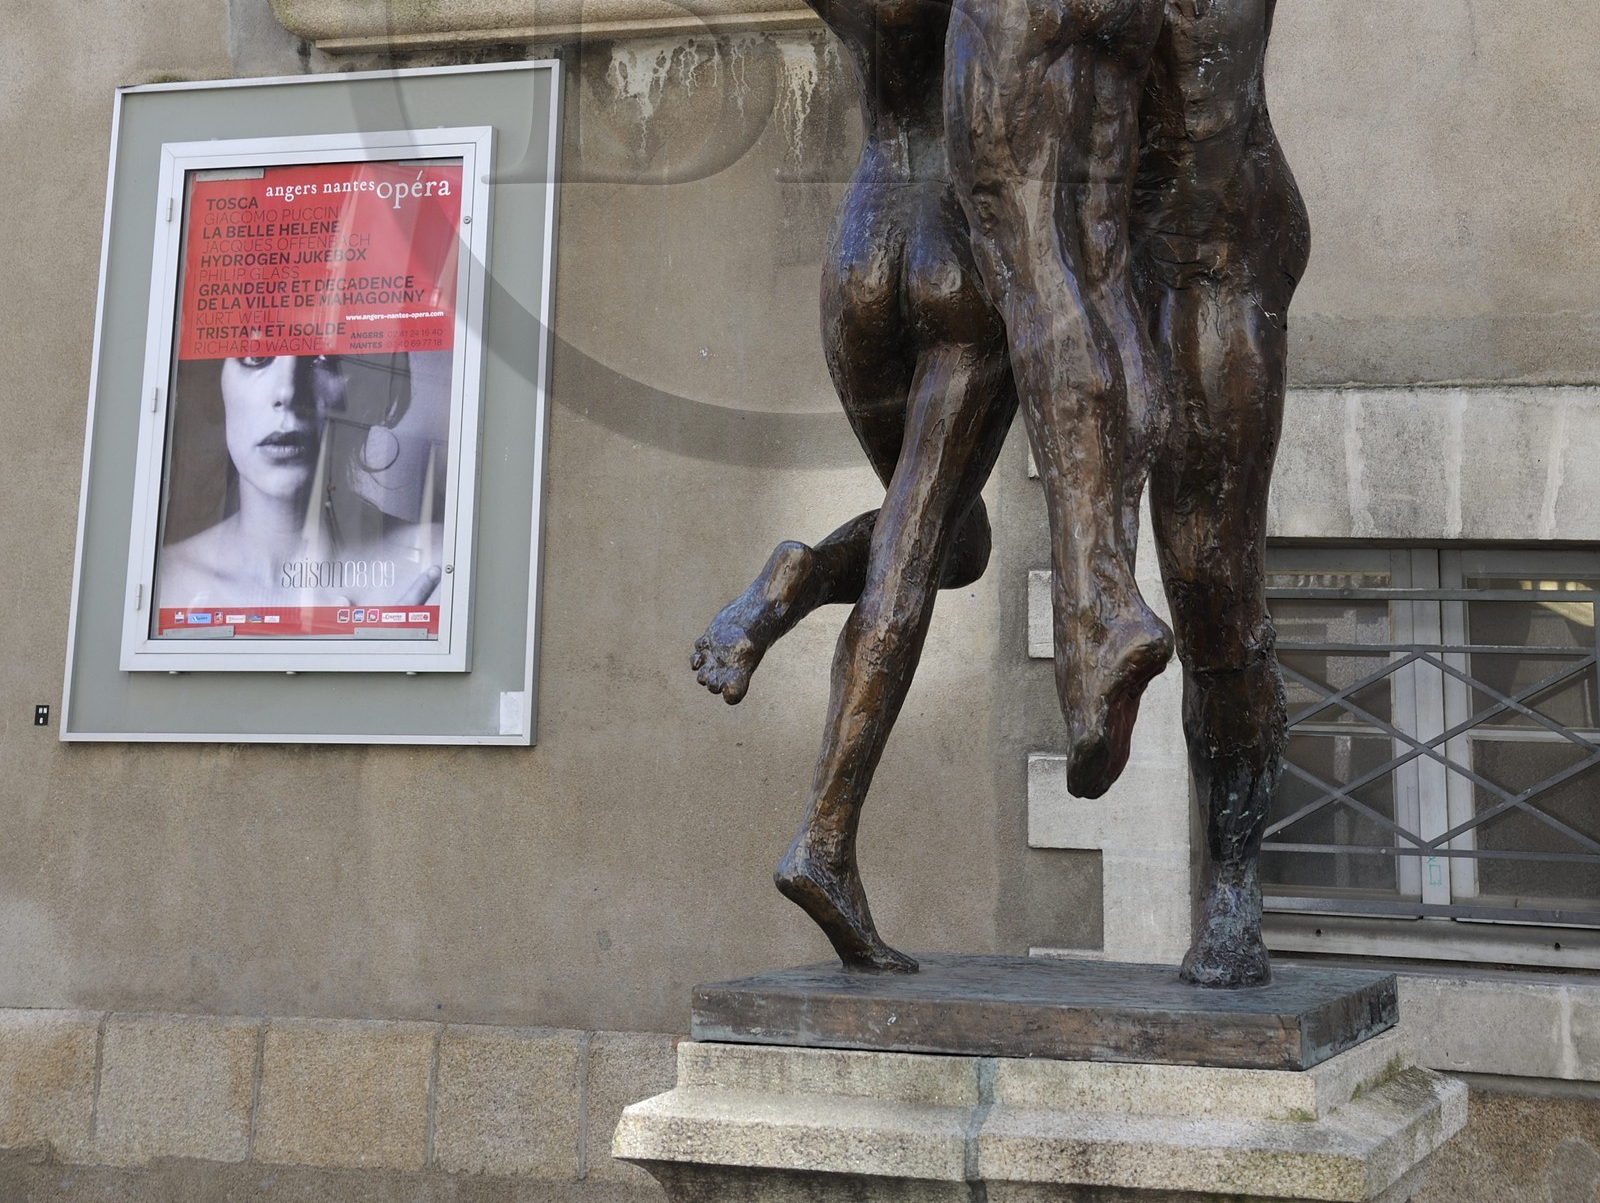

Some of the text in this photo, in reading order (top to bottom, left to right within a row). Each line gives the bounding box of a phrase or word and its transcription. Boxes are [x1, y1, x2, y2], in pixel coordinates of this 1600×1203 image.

[266, 170, 451, 209] angers nantes opéra
[207, 197, 258, 211] TOSCA
[204, 209, 278, 225] GIACOMO
[203, 221, 340, 239] LA BELLE HELENE
[202, 233, 370, 254] JACQUES OFFENBACH
[201, 248, 366, 268] HYDROGEN JUKEBOX
[200, 266, 300, 282] PHILIP GLASS
[199, 275, 414, 296] GRANDEUR ET DECADENCE
[197, 289, 424, 311] DE LA VILLE DE MAHAGONNY
[196, 309, 285, 326] KURT WEILL
[345, 311, 444, 321] www.angers-nantes-opera.com
[196, 322, 346, 340] TRISTAN ET ISOLDE
[350, 331, 384, 339] ANGERS
[194, 337, 334, 354] RICHARD WAGNER
[349, 341, 383, 349] NANTES
